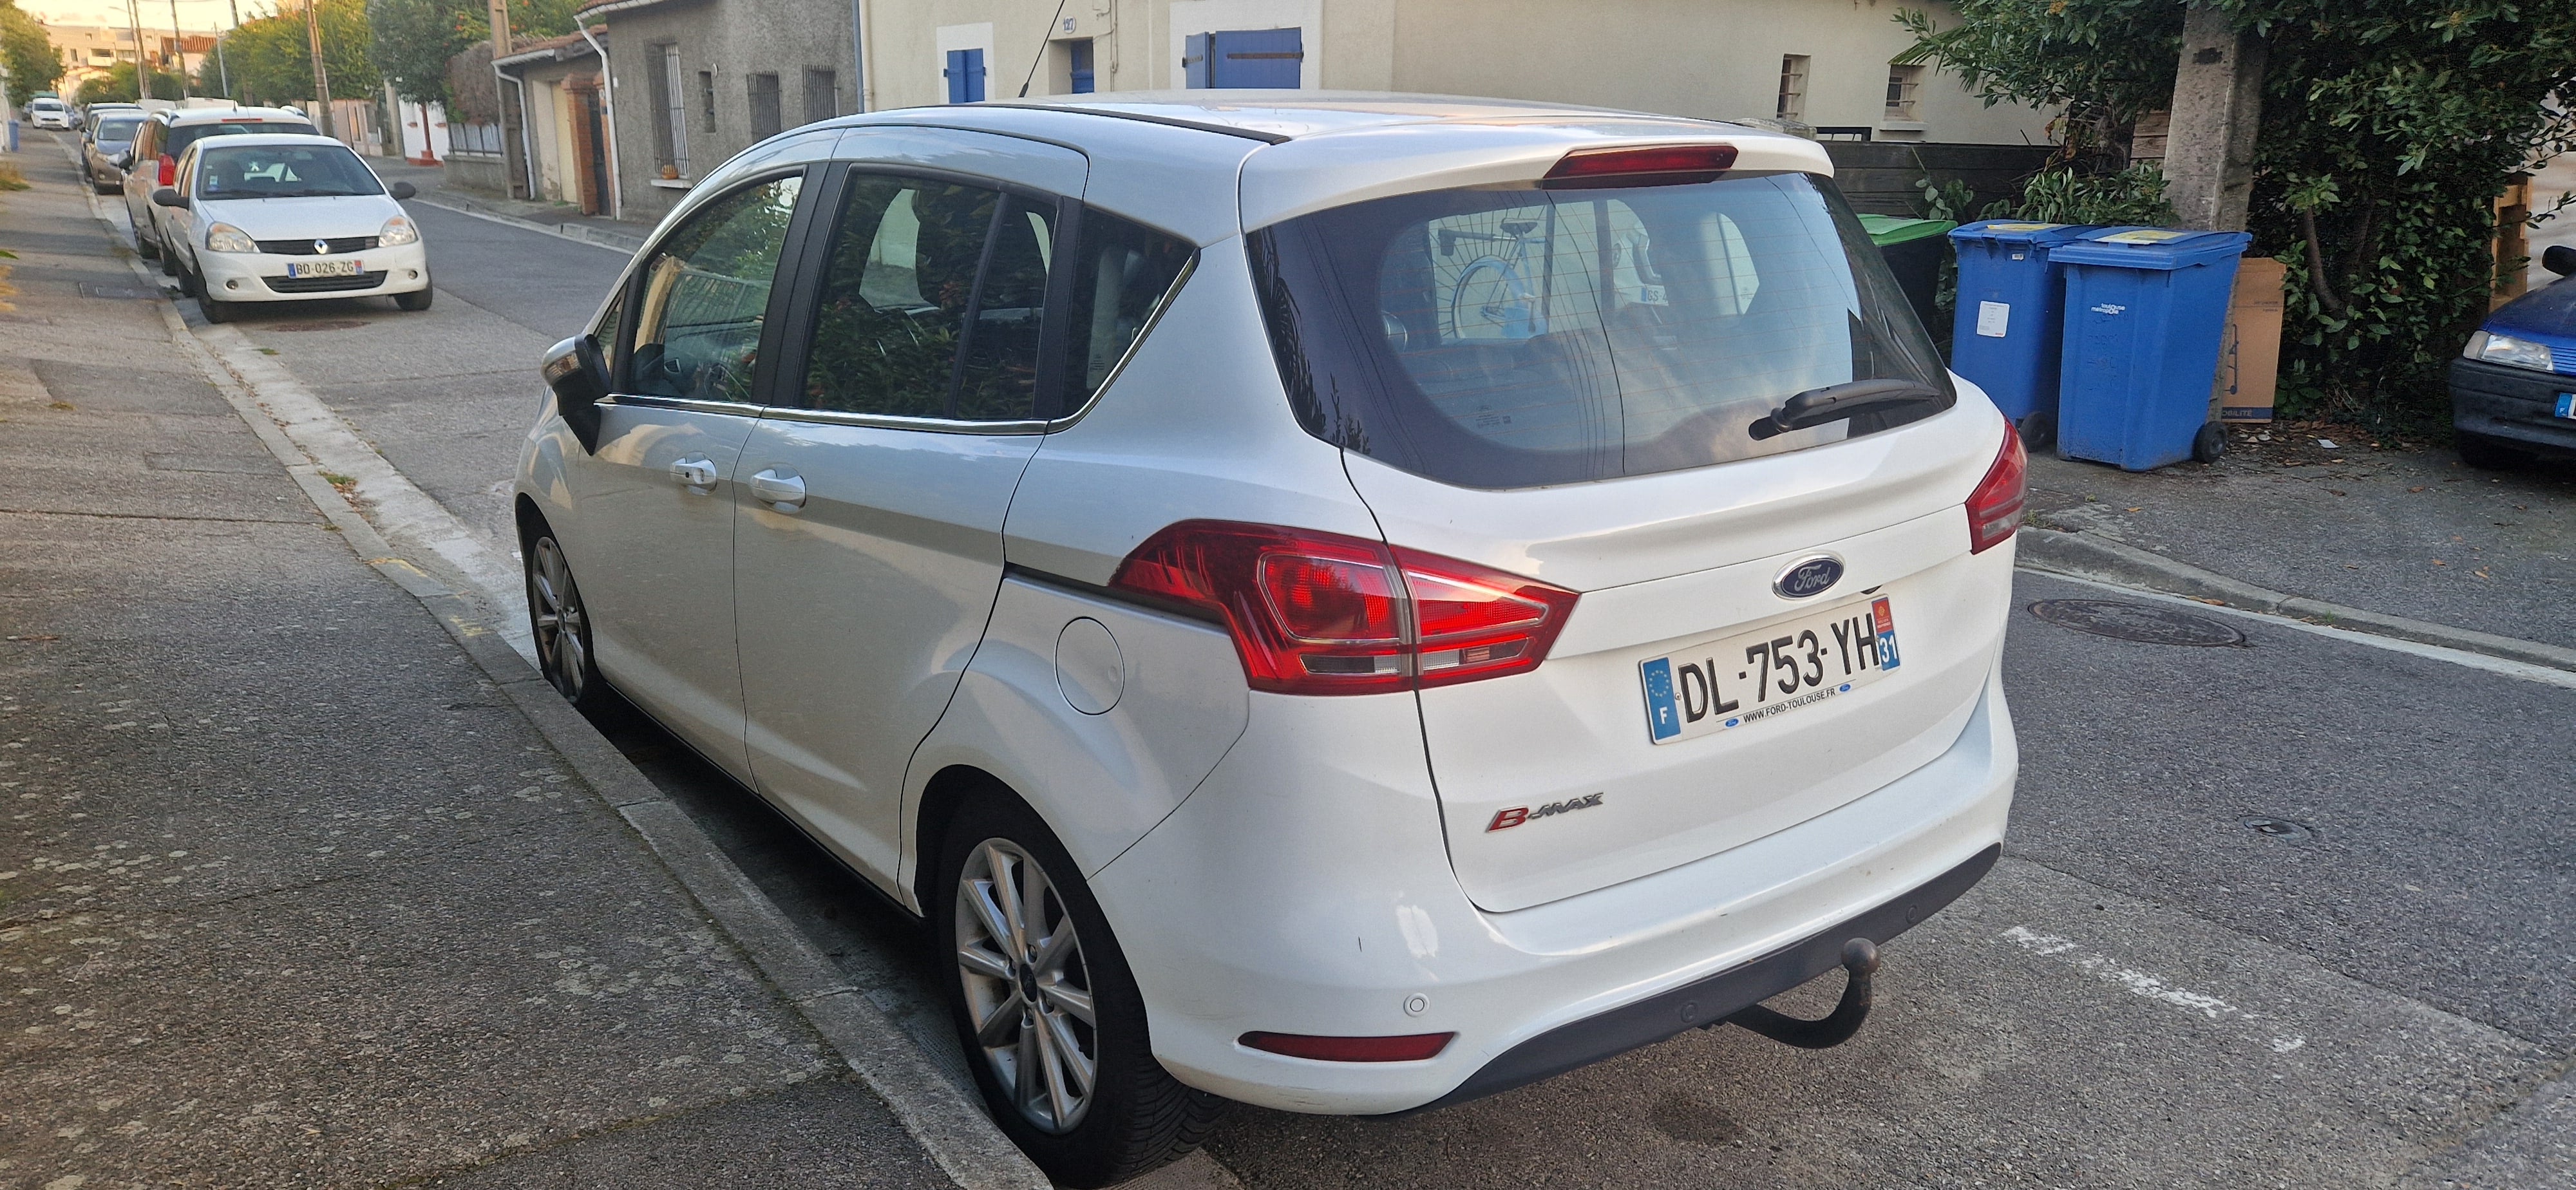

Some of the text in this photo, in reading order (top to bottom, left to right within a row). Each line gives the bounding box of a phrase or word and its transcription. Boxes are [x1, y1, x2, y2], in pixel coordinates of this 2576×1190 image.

[1063, 18, 1074, 30] 127
[1794, 564, 1831, 591] Ford
[1659, 706, 1669, 724] F
[1880, 634, 1898, 663] 31
[1743, 688, 1835, 723] WWW.FORD-TOULOUSE.FR
[1485, 792, 1604, 833] B-MAX
